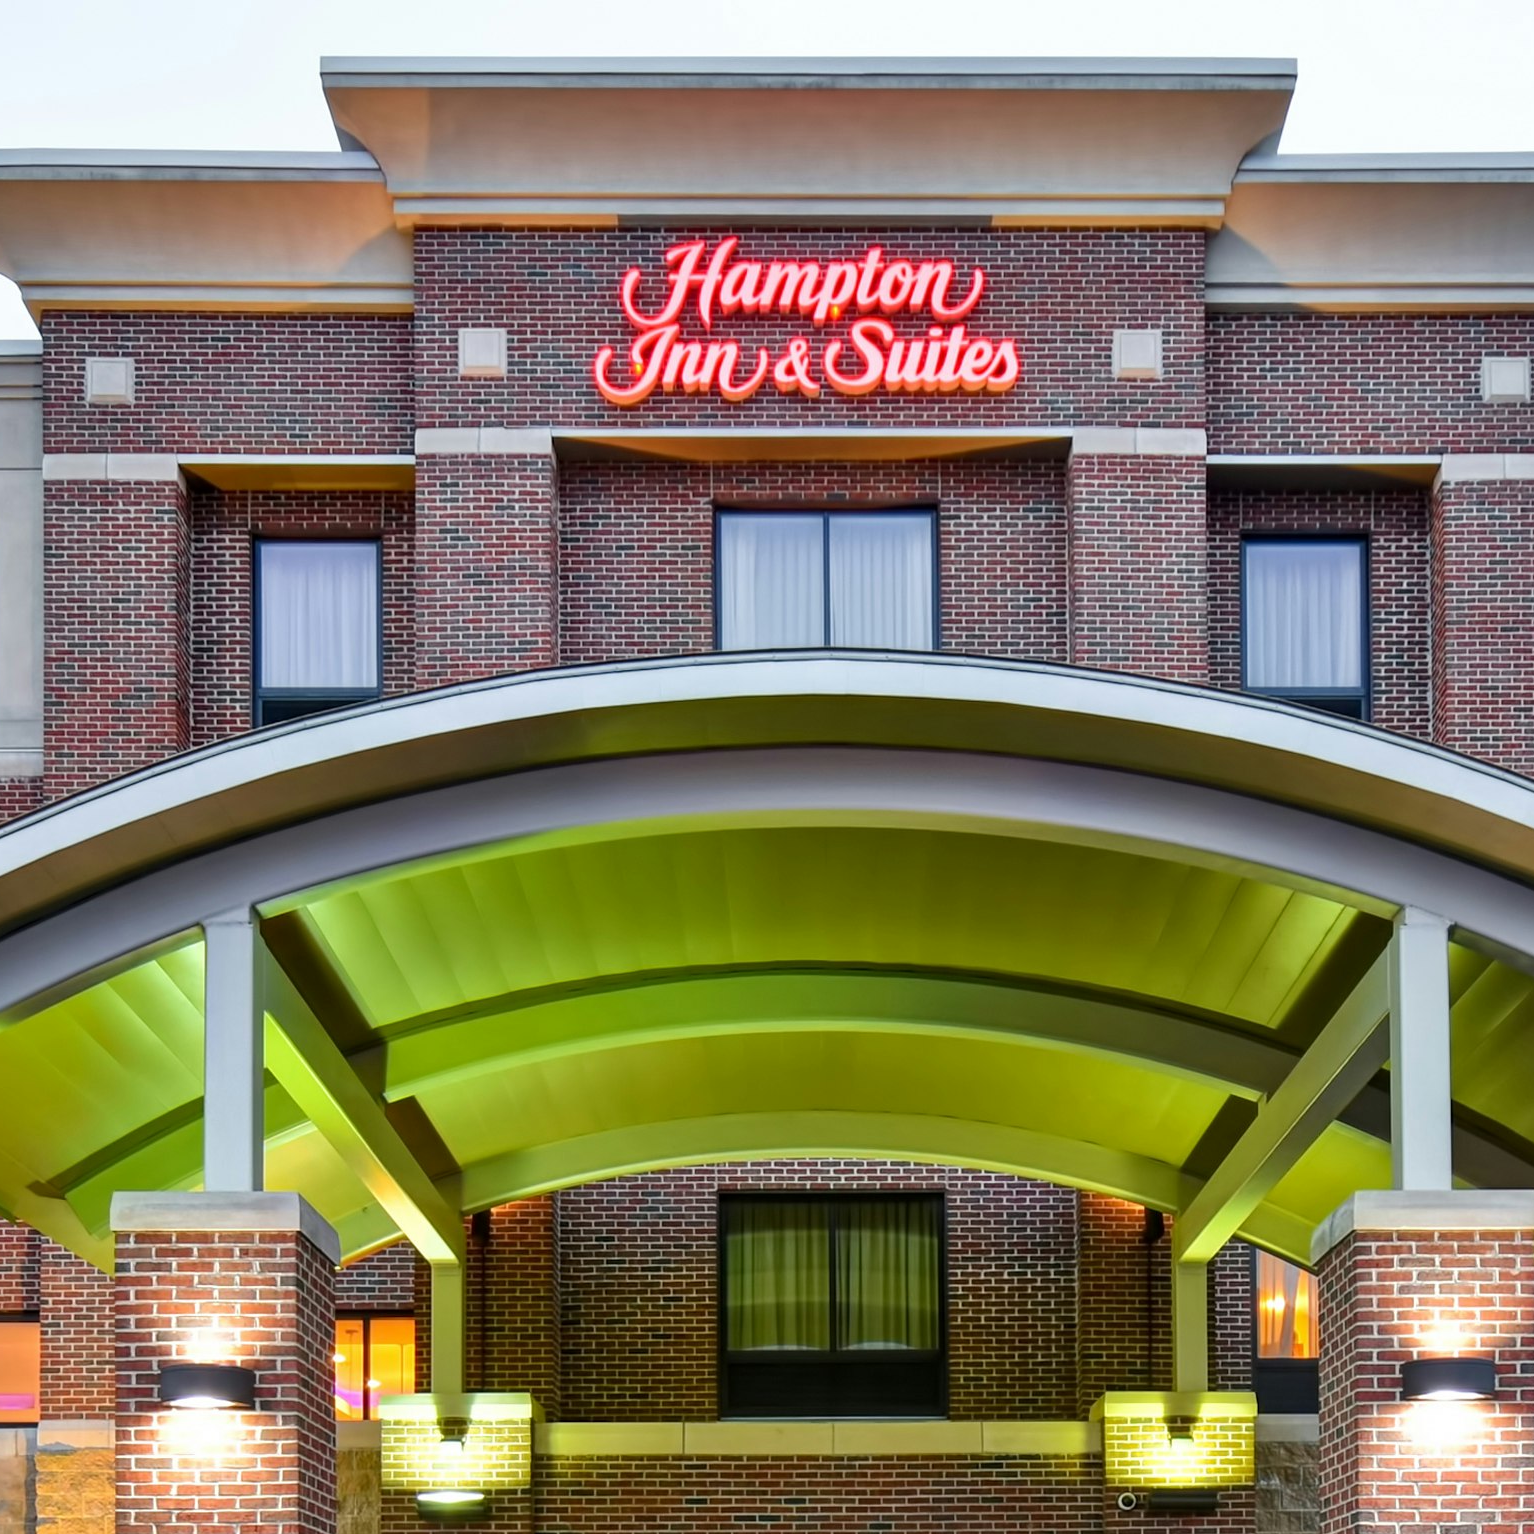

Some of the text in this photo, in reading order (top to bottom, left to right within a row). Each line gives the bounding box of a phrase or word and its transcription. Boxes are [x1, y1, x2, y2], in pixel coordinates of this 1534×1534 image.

[622, 236, 984, 331] Hampton
[595, 318, 1020, 405] Inn & Suites
